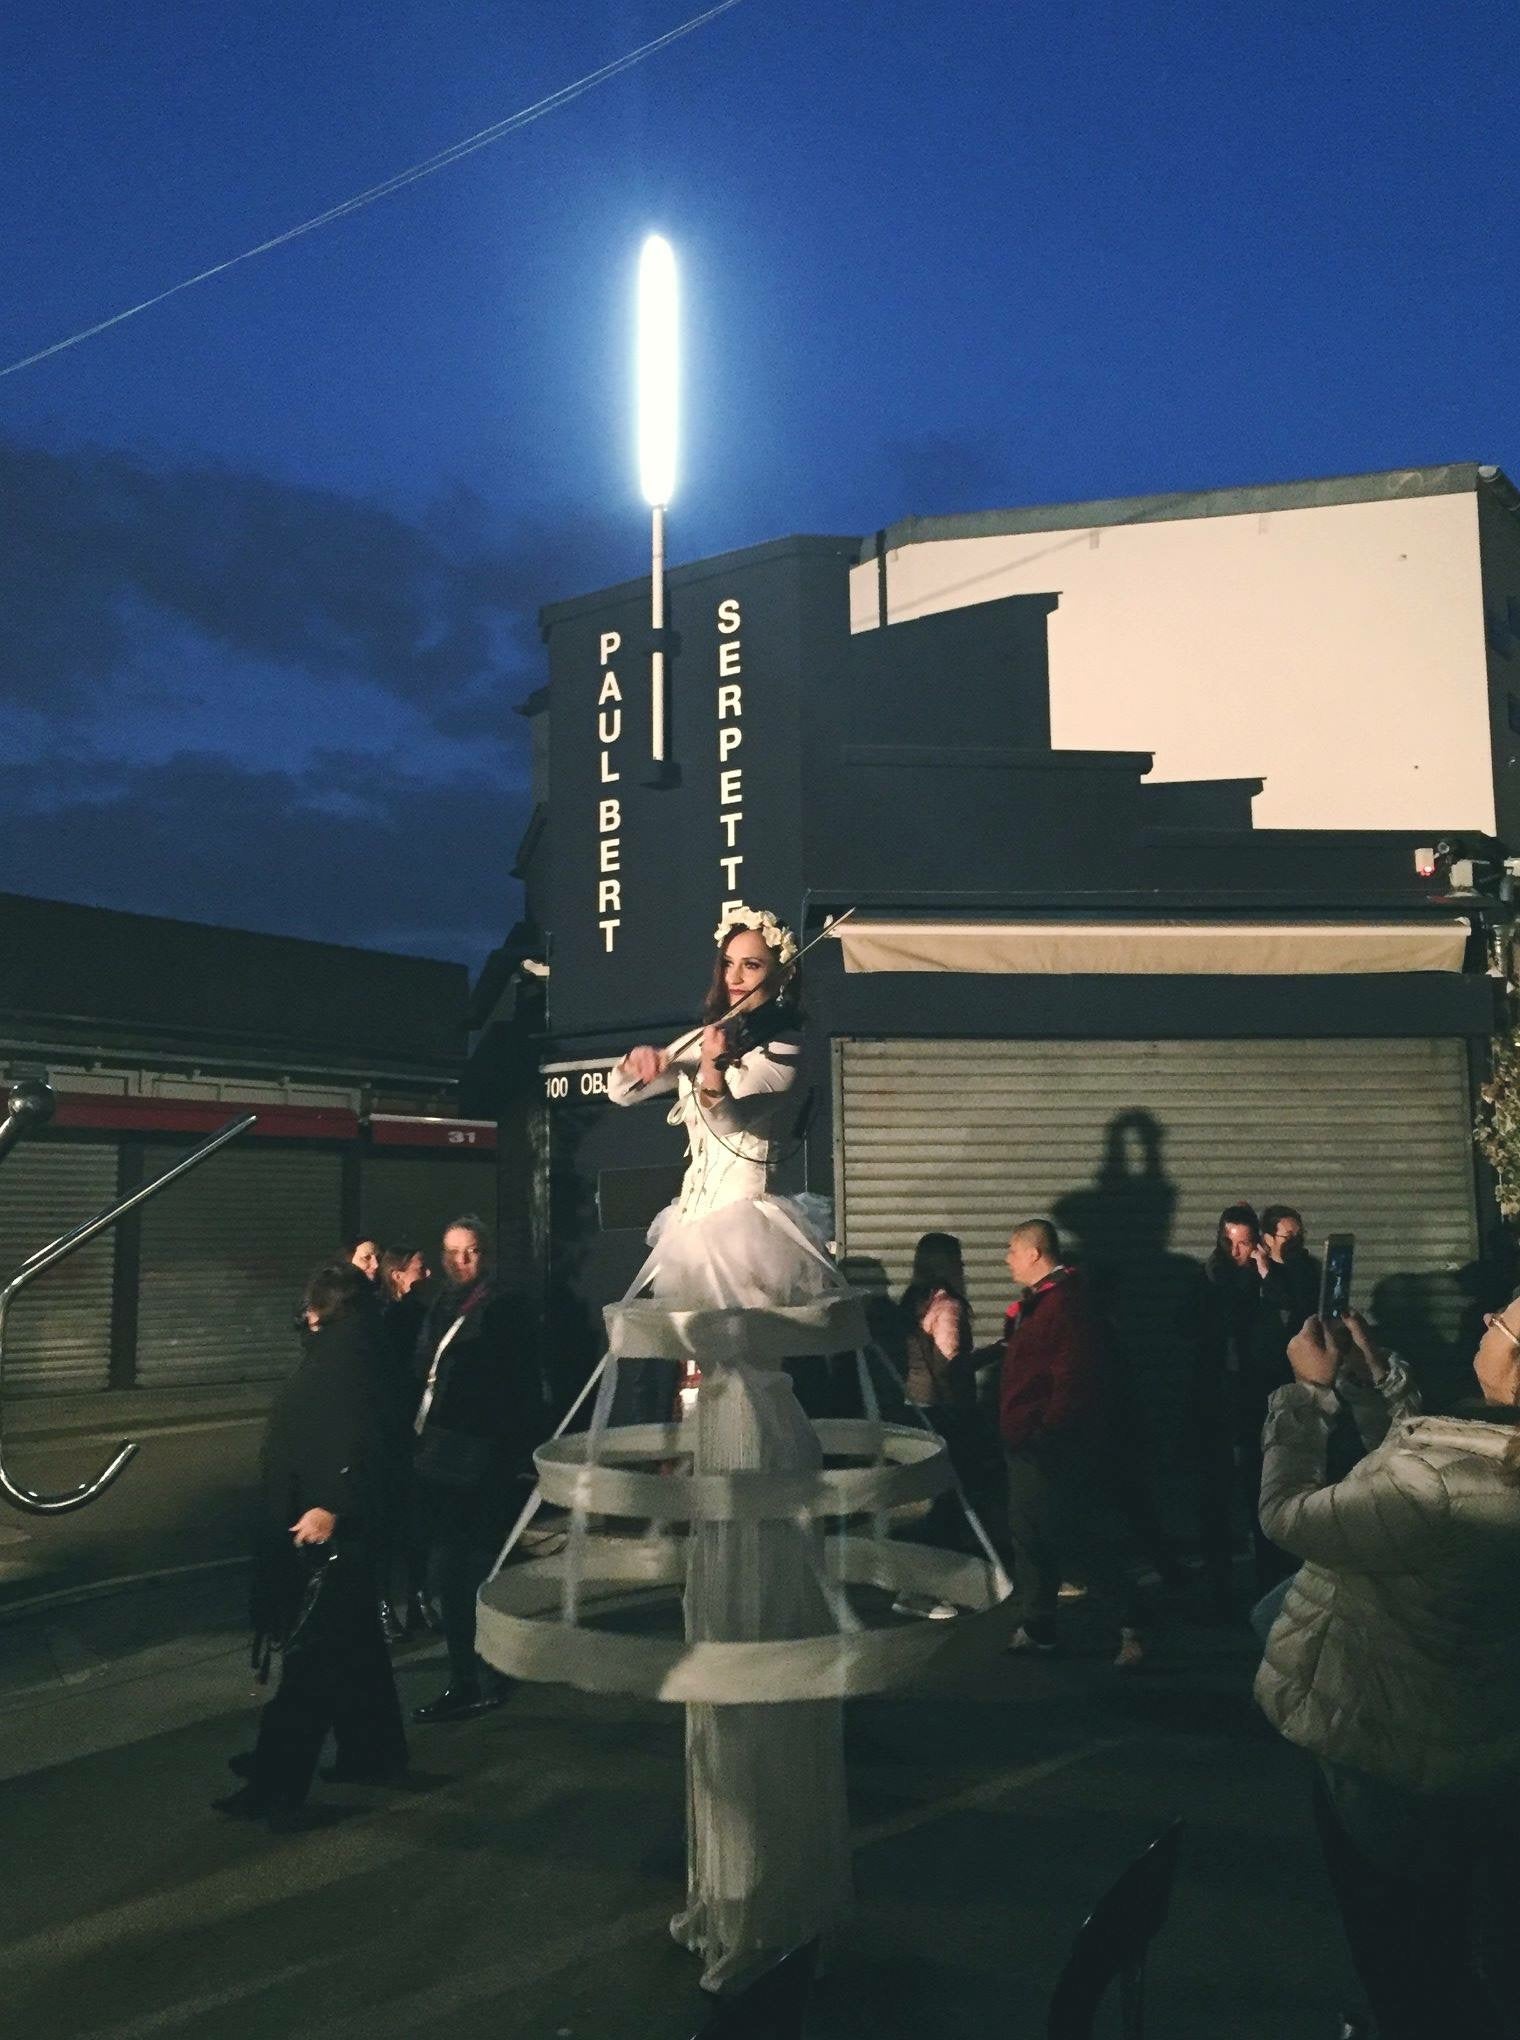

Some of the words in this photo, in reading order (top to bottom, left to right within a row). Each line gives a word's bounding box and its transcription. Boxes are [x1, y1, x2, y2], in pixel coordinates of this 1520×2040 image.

[598, 631, 622, 783] PAUL
[598, 798, 621, 953] BERT
[545, 1077, 569, 1098] 100
[448, 1131, 475, 1143] 31
